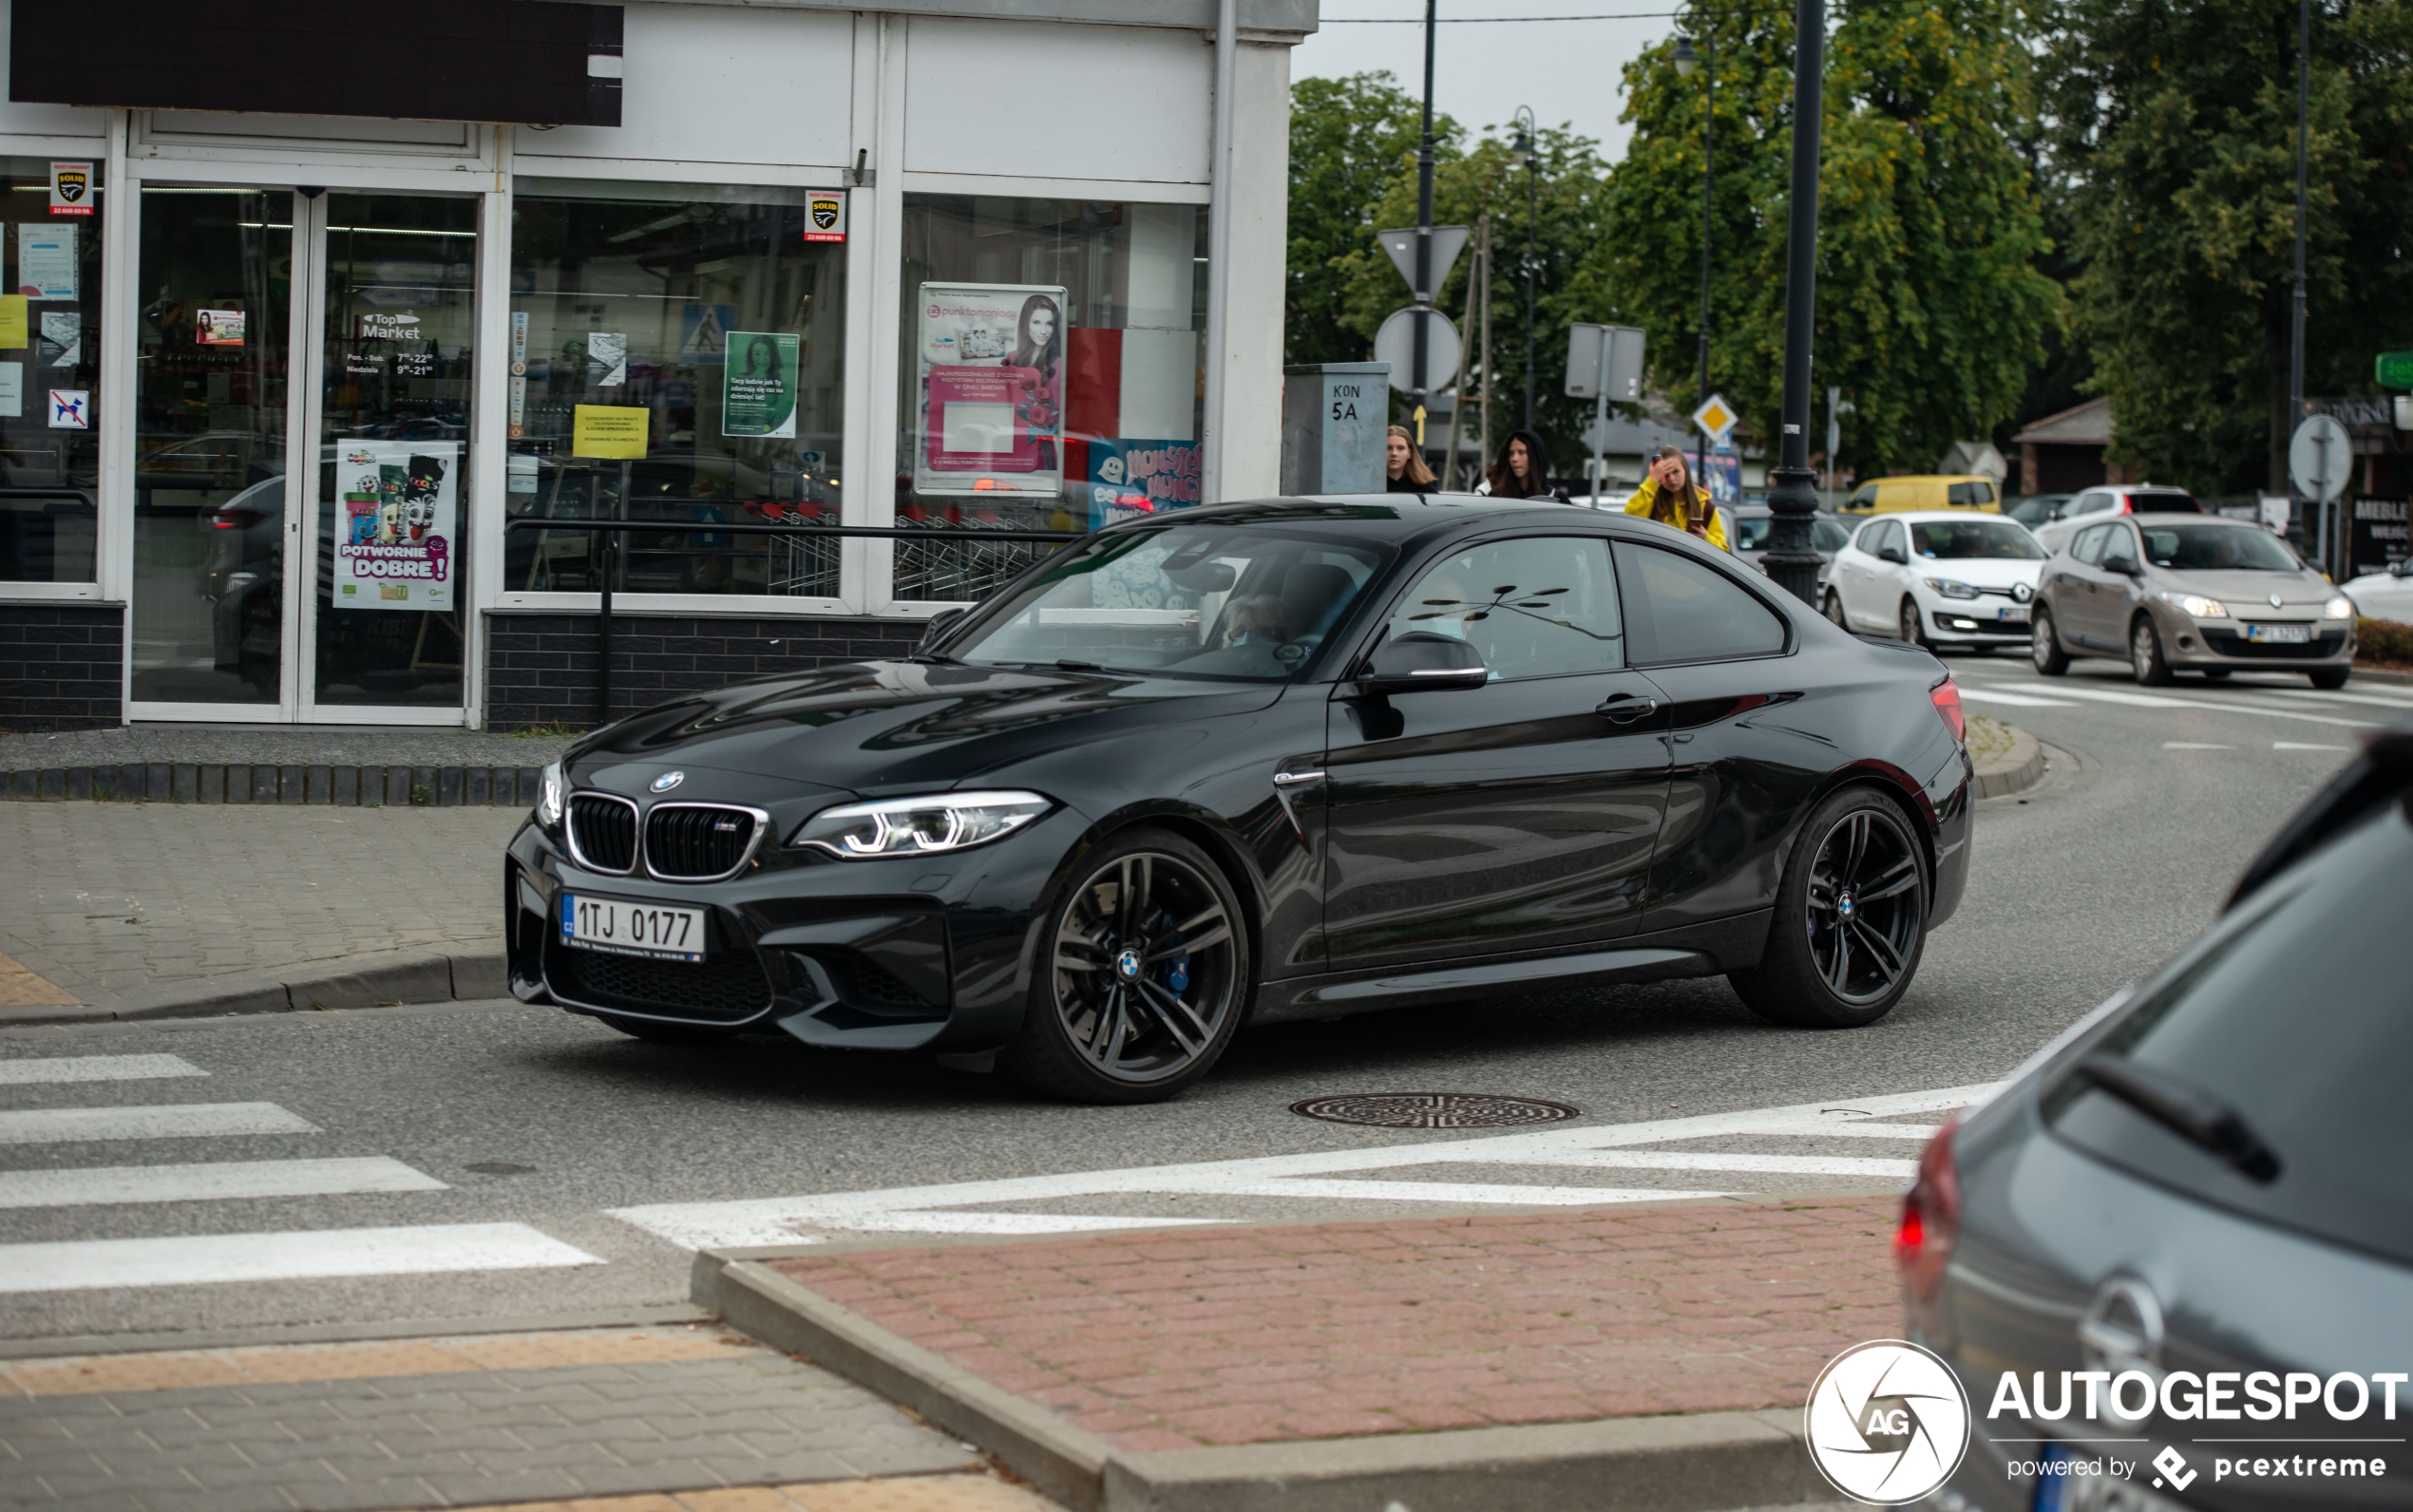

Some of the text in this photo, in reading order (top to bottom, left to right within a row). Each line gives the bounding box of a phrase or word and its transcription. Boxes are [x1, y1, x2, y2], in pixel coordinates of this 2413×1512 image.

[374, 313, 396, 327] Top
[941, 306, 1016, 321] punktomaniacy
[363, 325, 420, 340] Market
[346, 366, 378, 374] Niedziela
[1332, 402, 1358, 421] 5A
[2355, 500, 2408, 520] MEBLE
[342, 545, 428, 558] POTWORNIE
[564, 921, 574, 933] CZ
[580, 902, 692, 947] 1TJ 0177
